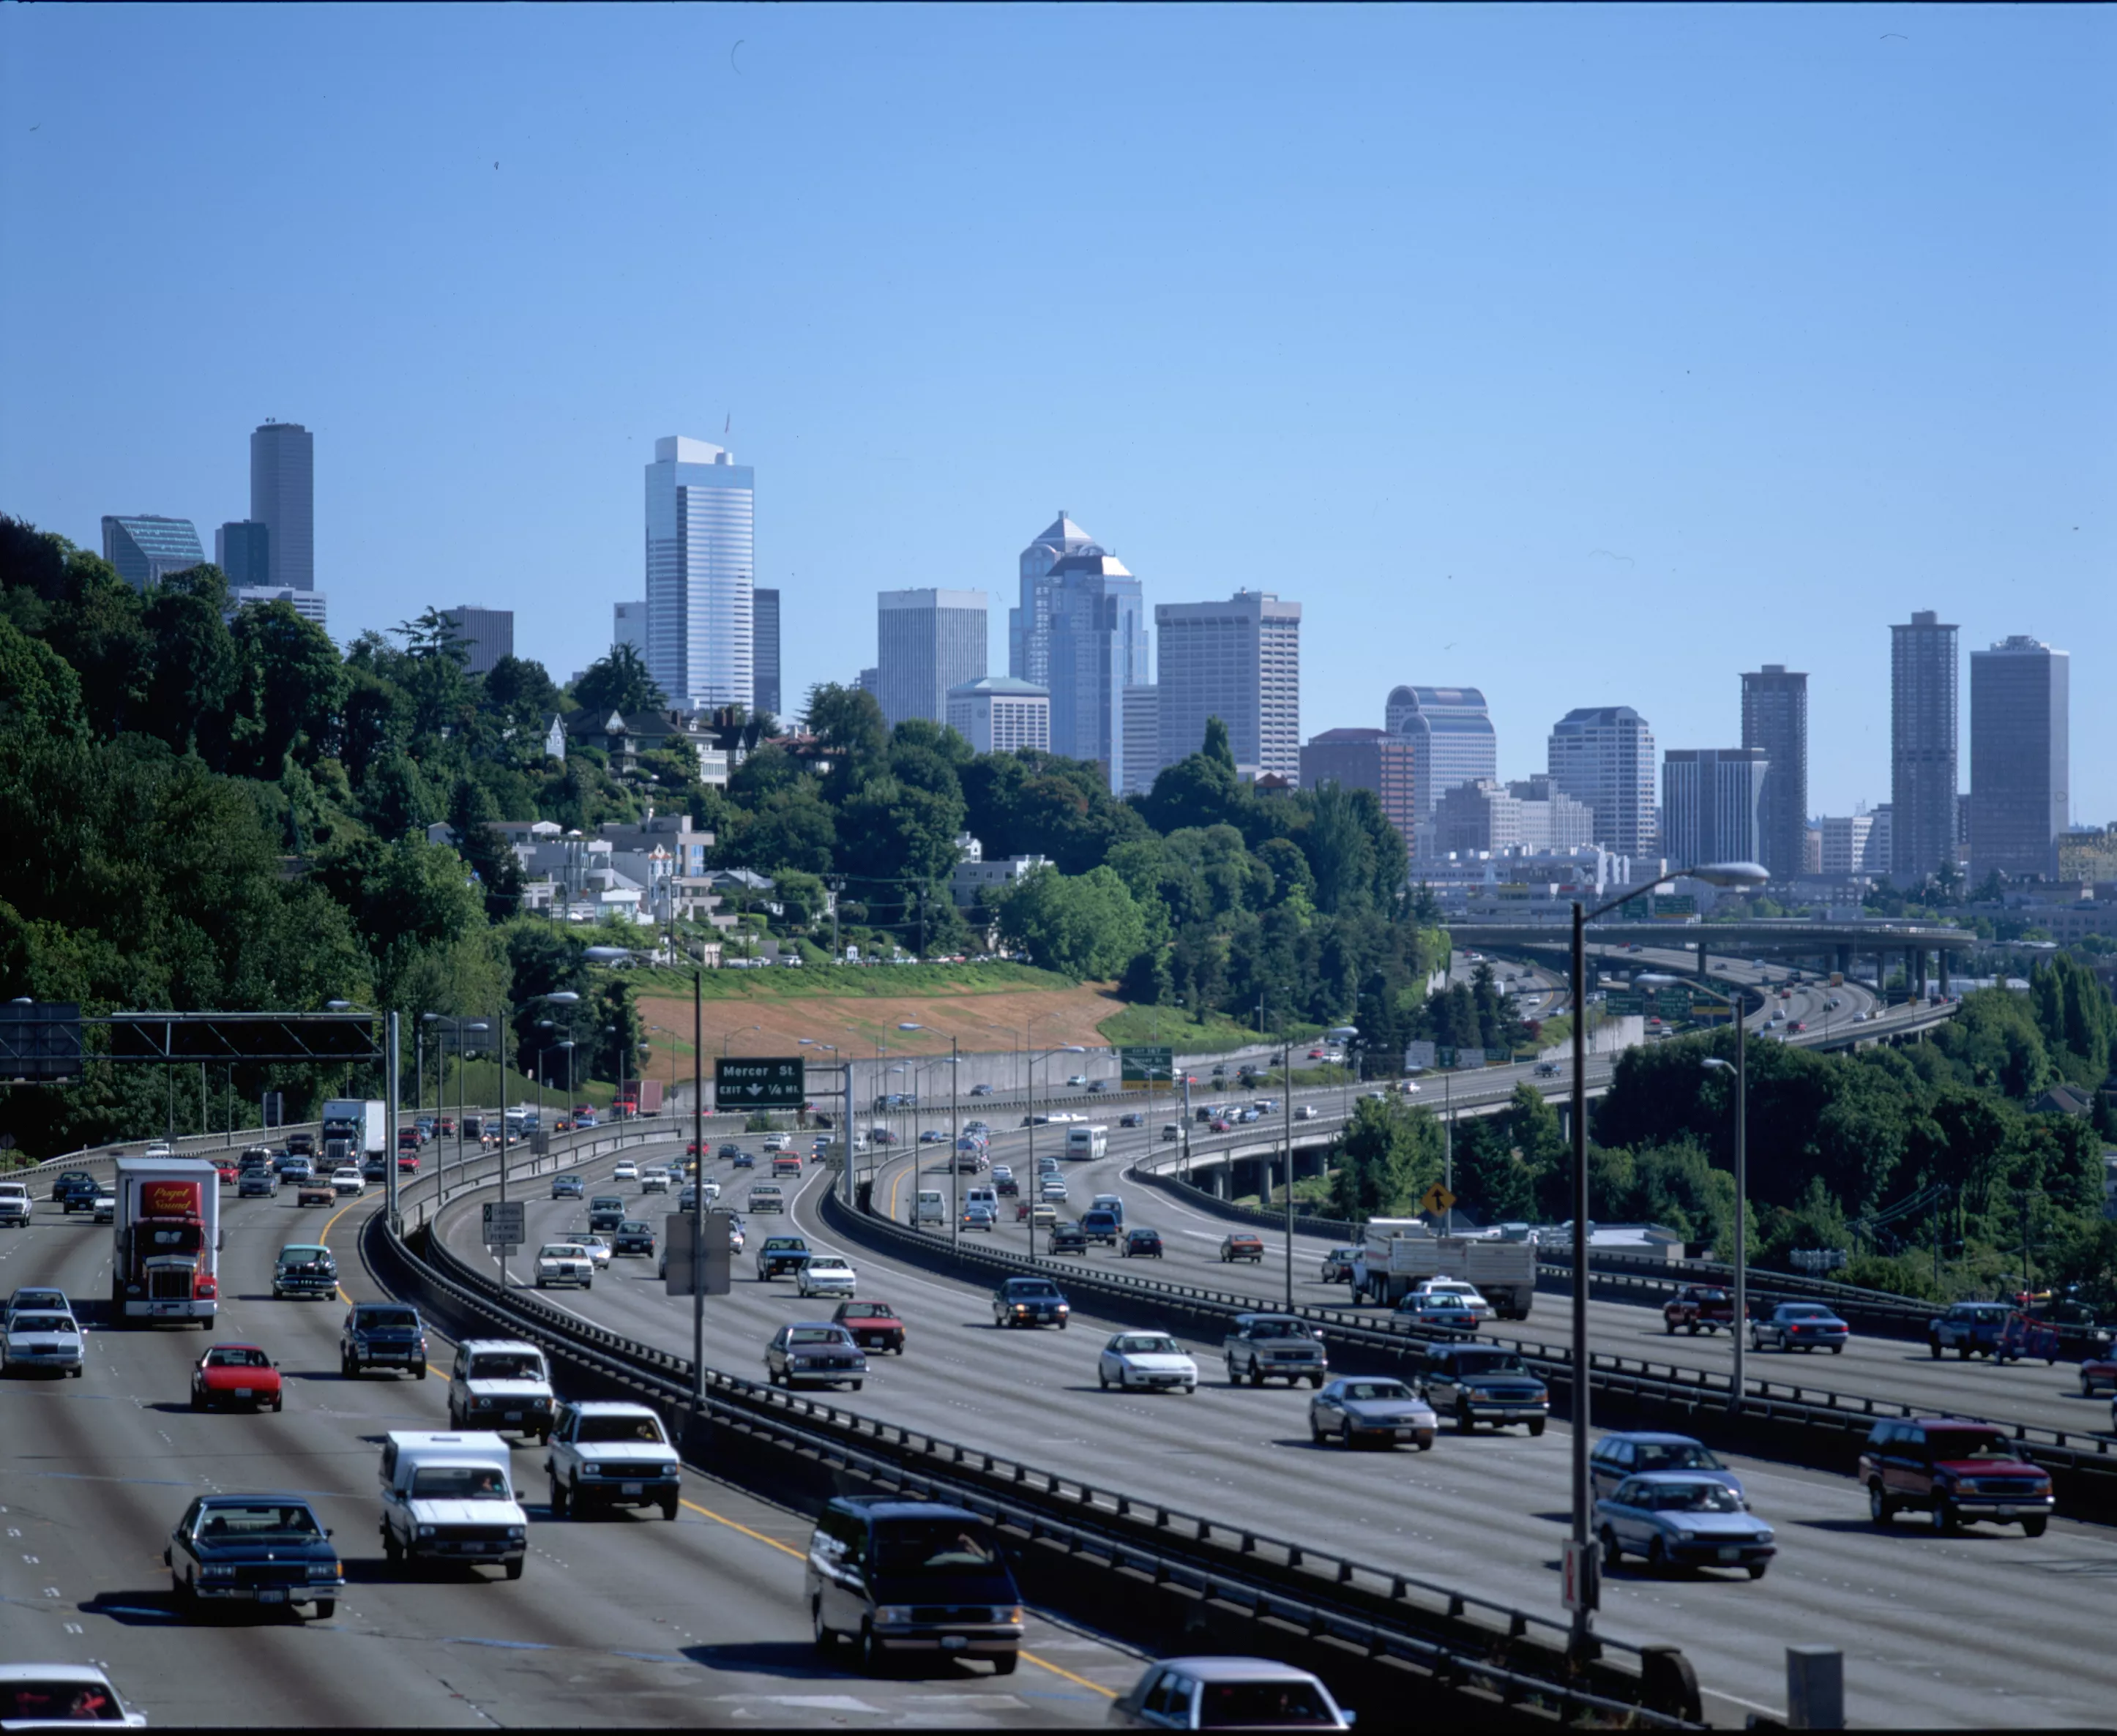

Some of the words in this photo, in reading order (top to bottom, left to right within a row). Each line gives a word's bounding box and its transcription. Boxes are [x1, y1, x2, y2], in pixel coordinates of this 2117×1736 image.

[723, 1066, 769, 1077] Mercer
[779, 1065, 796, 1077] St.
[719, 1085, 742, 1095] EXIT
[829, 1158, 845, 1167] 55
[153, 1187, 191, 1201] Puget
[154, 1200, 192, 1210] Sound
